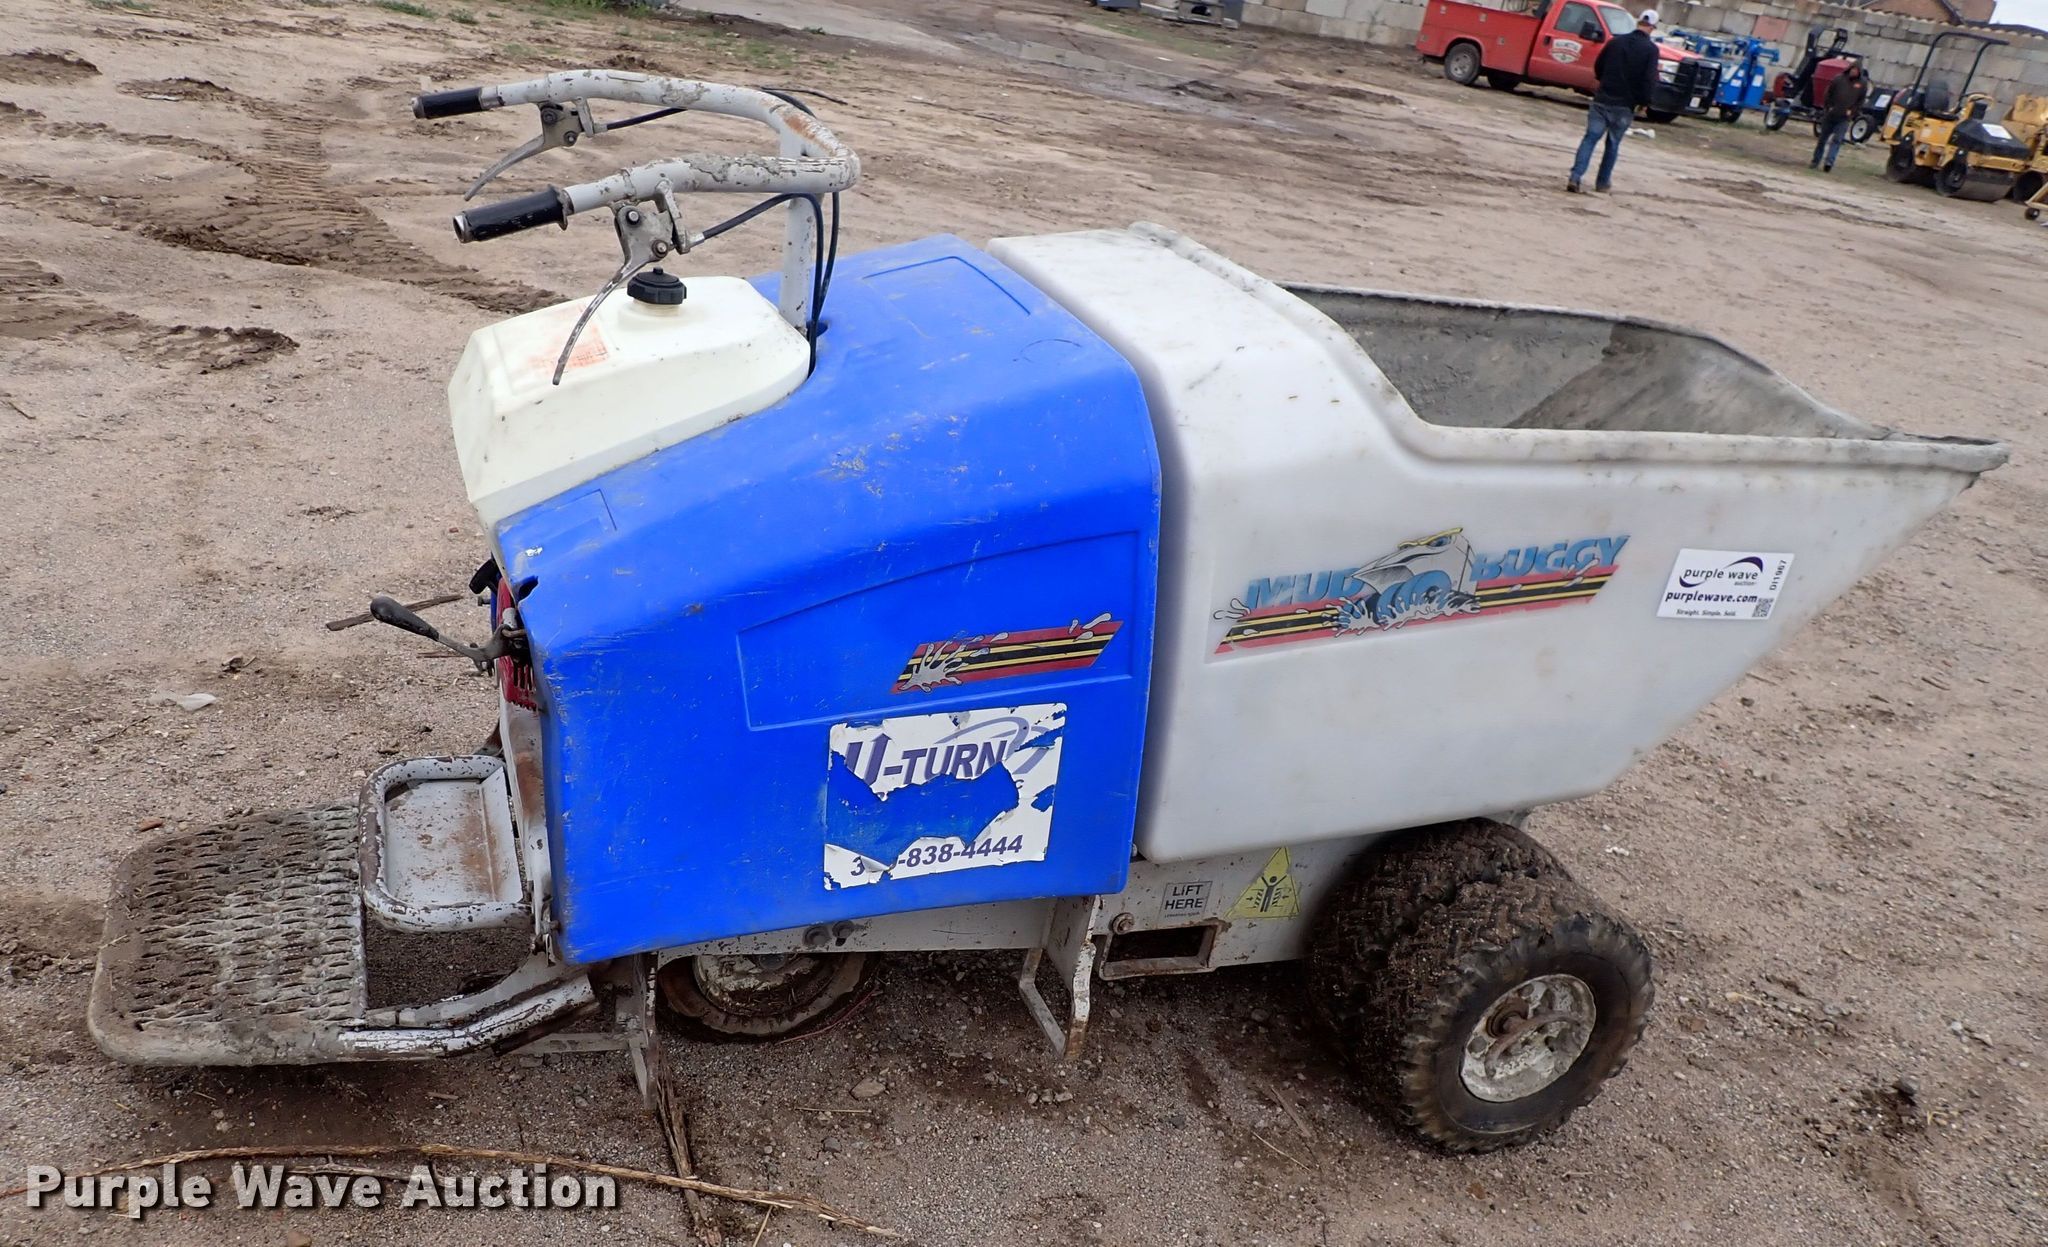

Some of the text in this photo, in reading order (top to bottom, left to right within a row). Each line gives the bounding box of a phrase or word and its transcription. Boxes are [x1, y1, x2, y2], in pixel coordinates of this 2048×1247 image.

[1246, 535, 1632, 609] MUD BUGGY
[1683, 568, 1759, 581] purple wave
[1665, 590, 1758, 604] purplewave.com
[844, 733, 1007, 786] U-TURN
[850, 834, 1023, 876] 3-838-4444
[1172, 885, 1203, 896] LIFT
[1165, 898, 1204, 910] HERE
